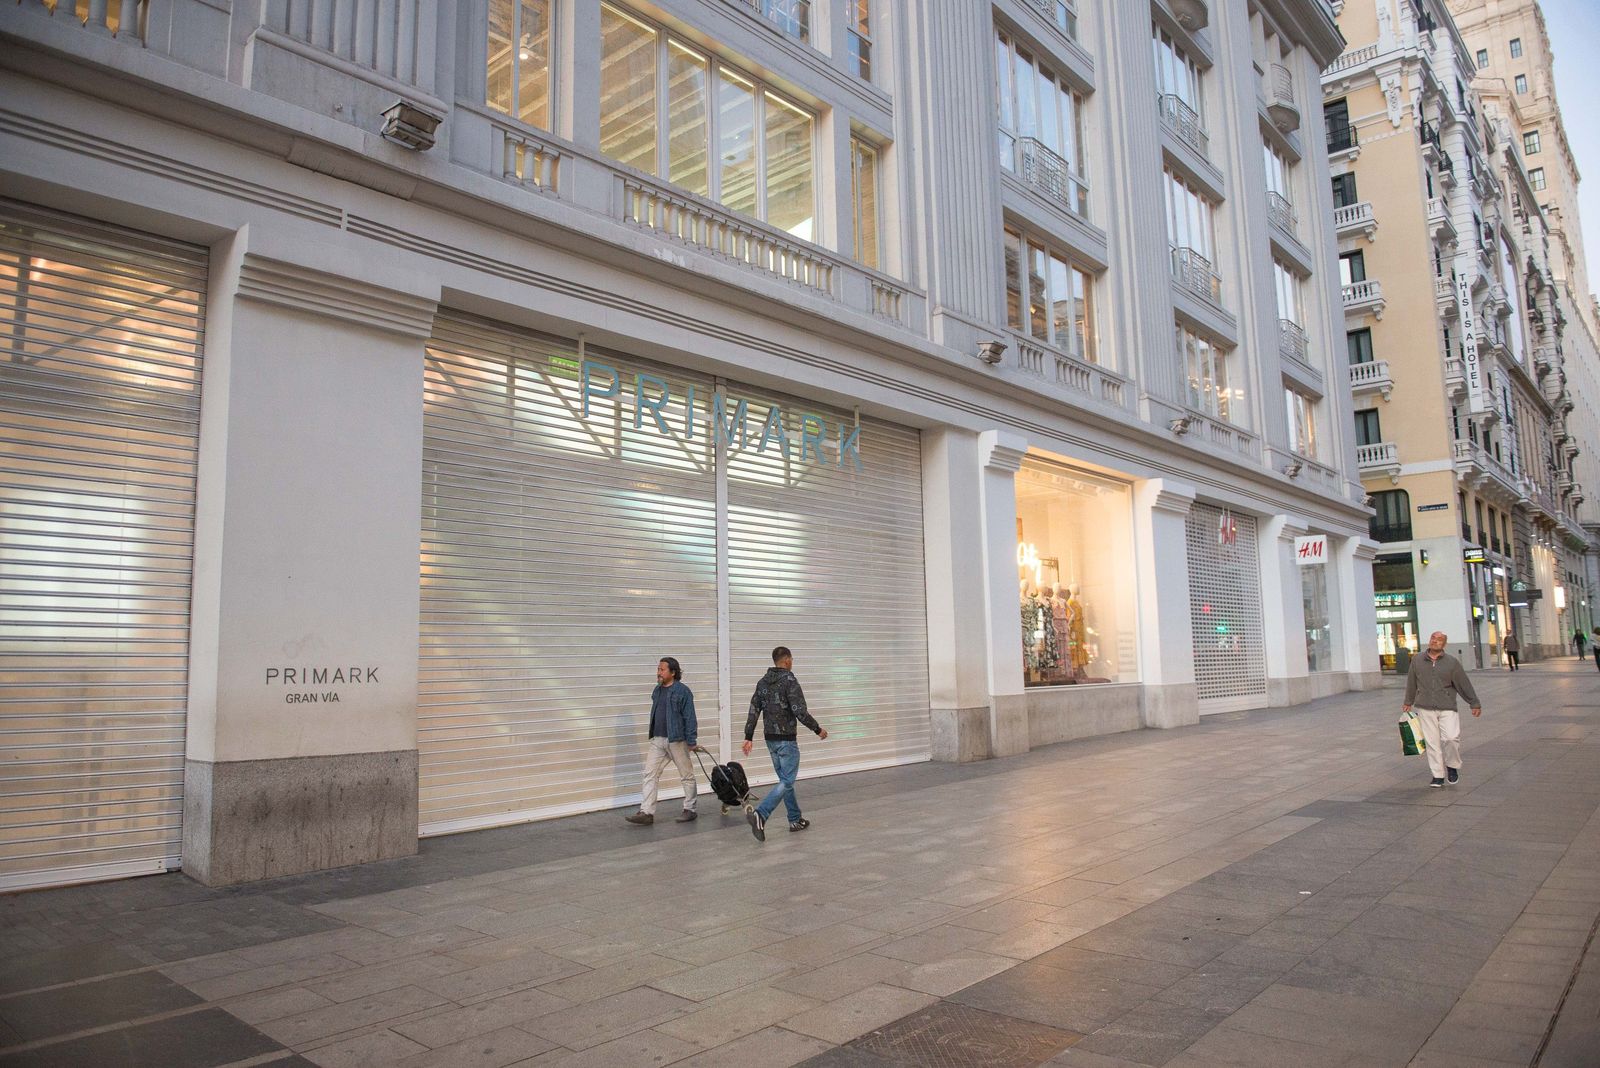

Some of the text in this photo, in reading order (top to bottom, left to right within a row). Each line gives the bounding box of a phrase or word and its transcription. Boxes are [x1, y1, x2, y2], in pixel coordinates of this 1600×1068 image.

[1459, 273, 1478, 388] THIS IS A HOTEL
[581, 360, 864, 472] PRIMARK
[1298, 541, 1323, 558] H&M
[266, 667, 380, 685] PRIMARK
[285, 693, 318, 703] GRAN
